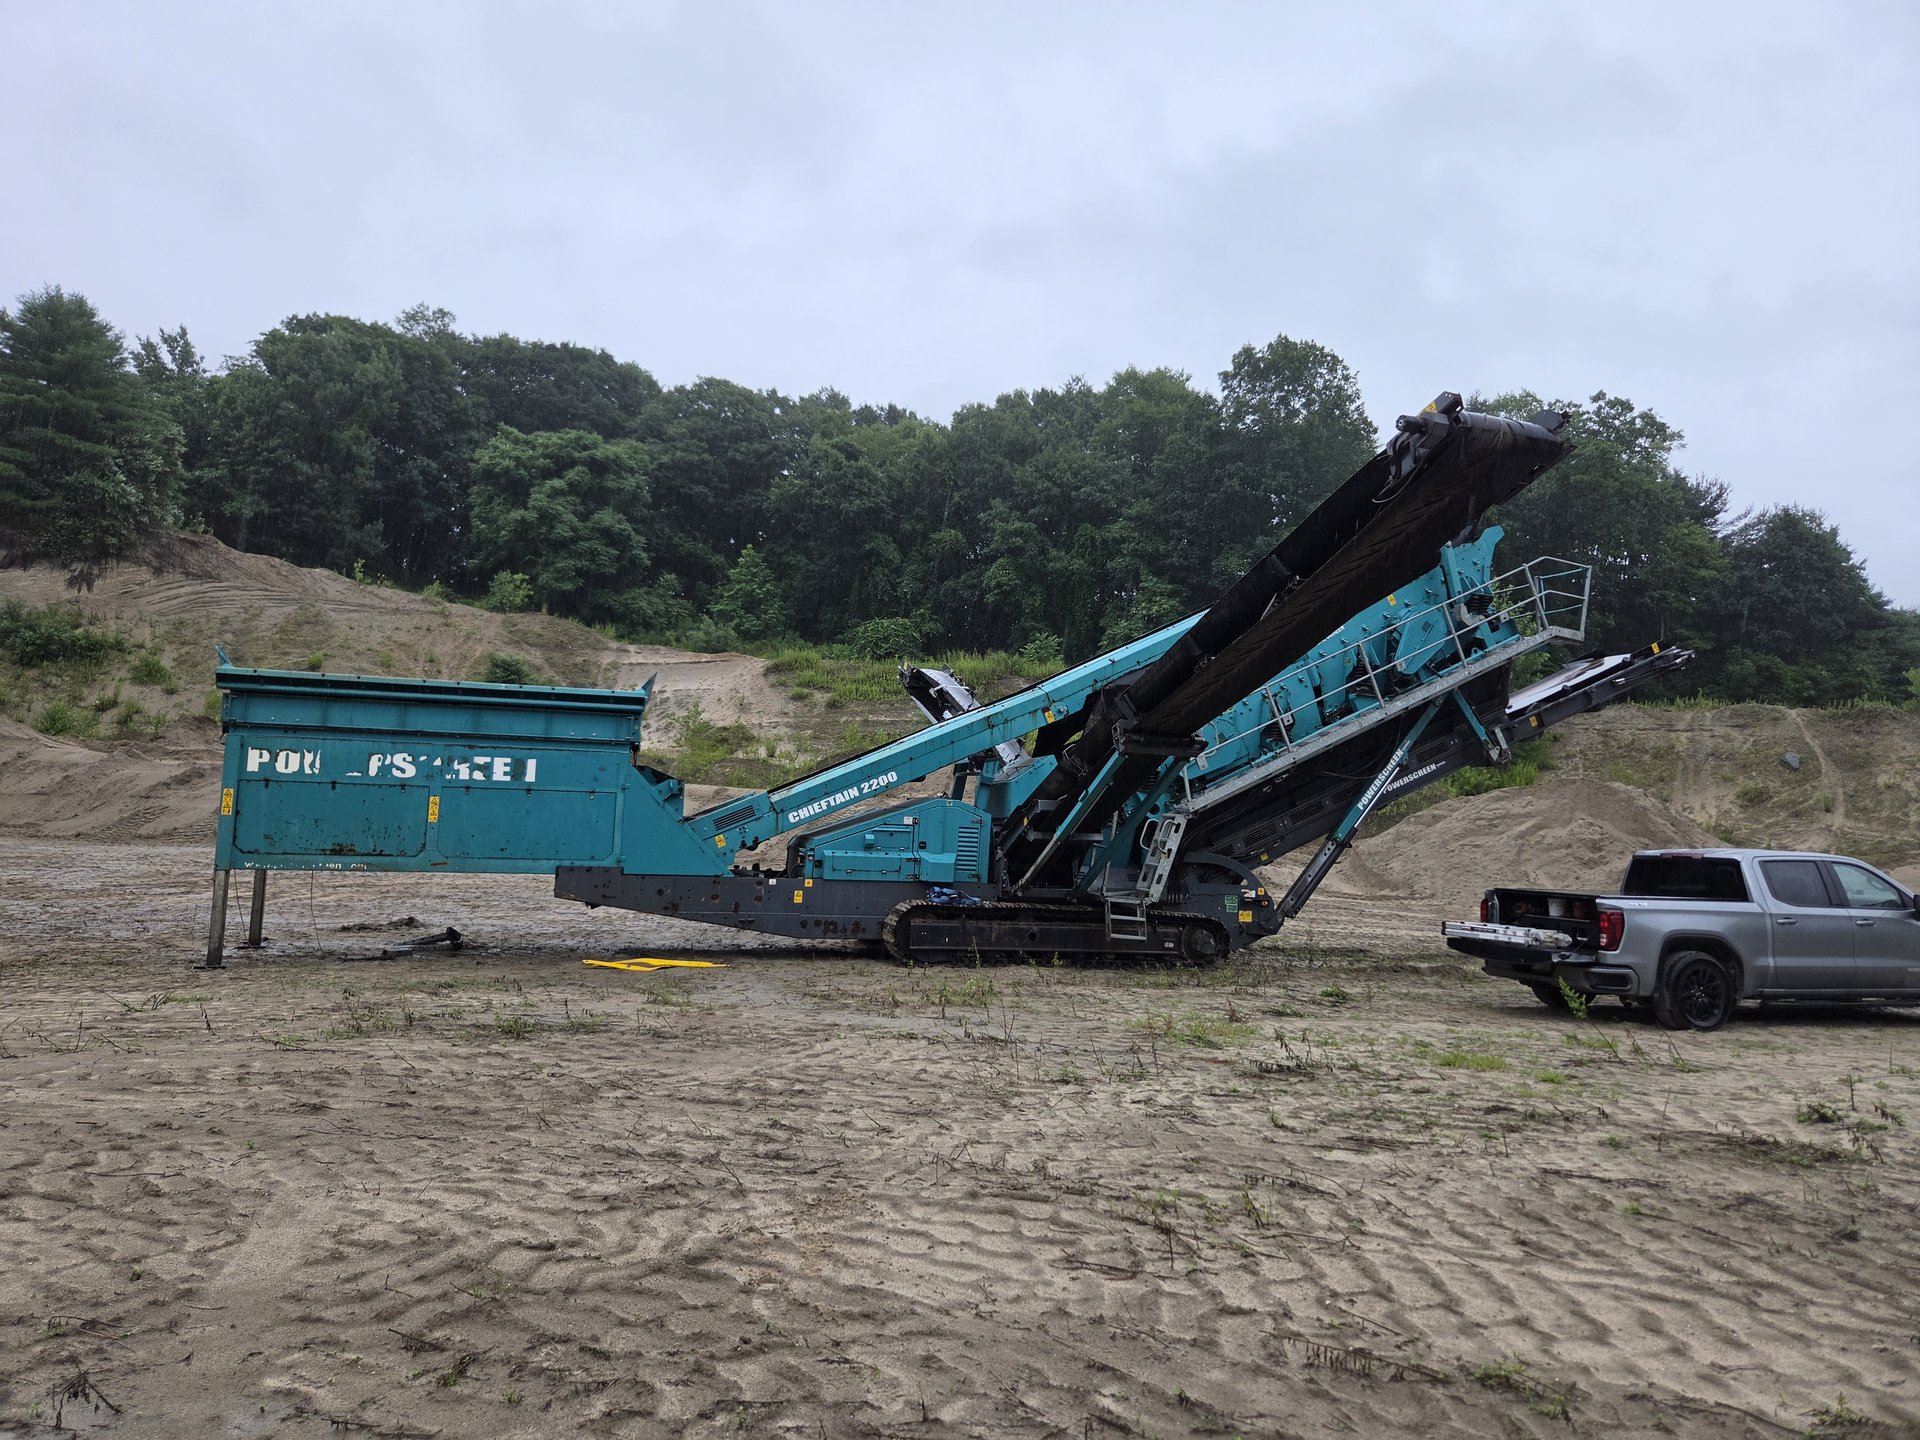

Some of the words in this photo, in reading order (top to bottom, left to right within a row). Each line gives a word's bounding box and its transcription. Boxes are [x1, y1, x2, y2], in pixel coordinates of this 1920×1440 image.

[787, 786, 860, 823] CHIEFTAIN
[860, 771, 898, 794] 2200
[1356, 748, 1404, 811] POWERSCREEN
